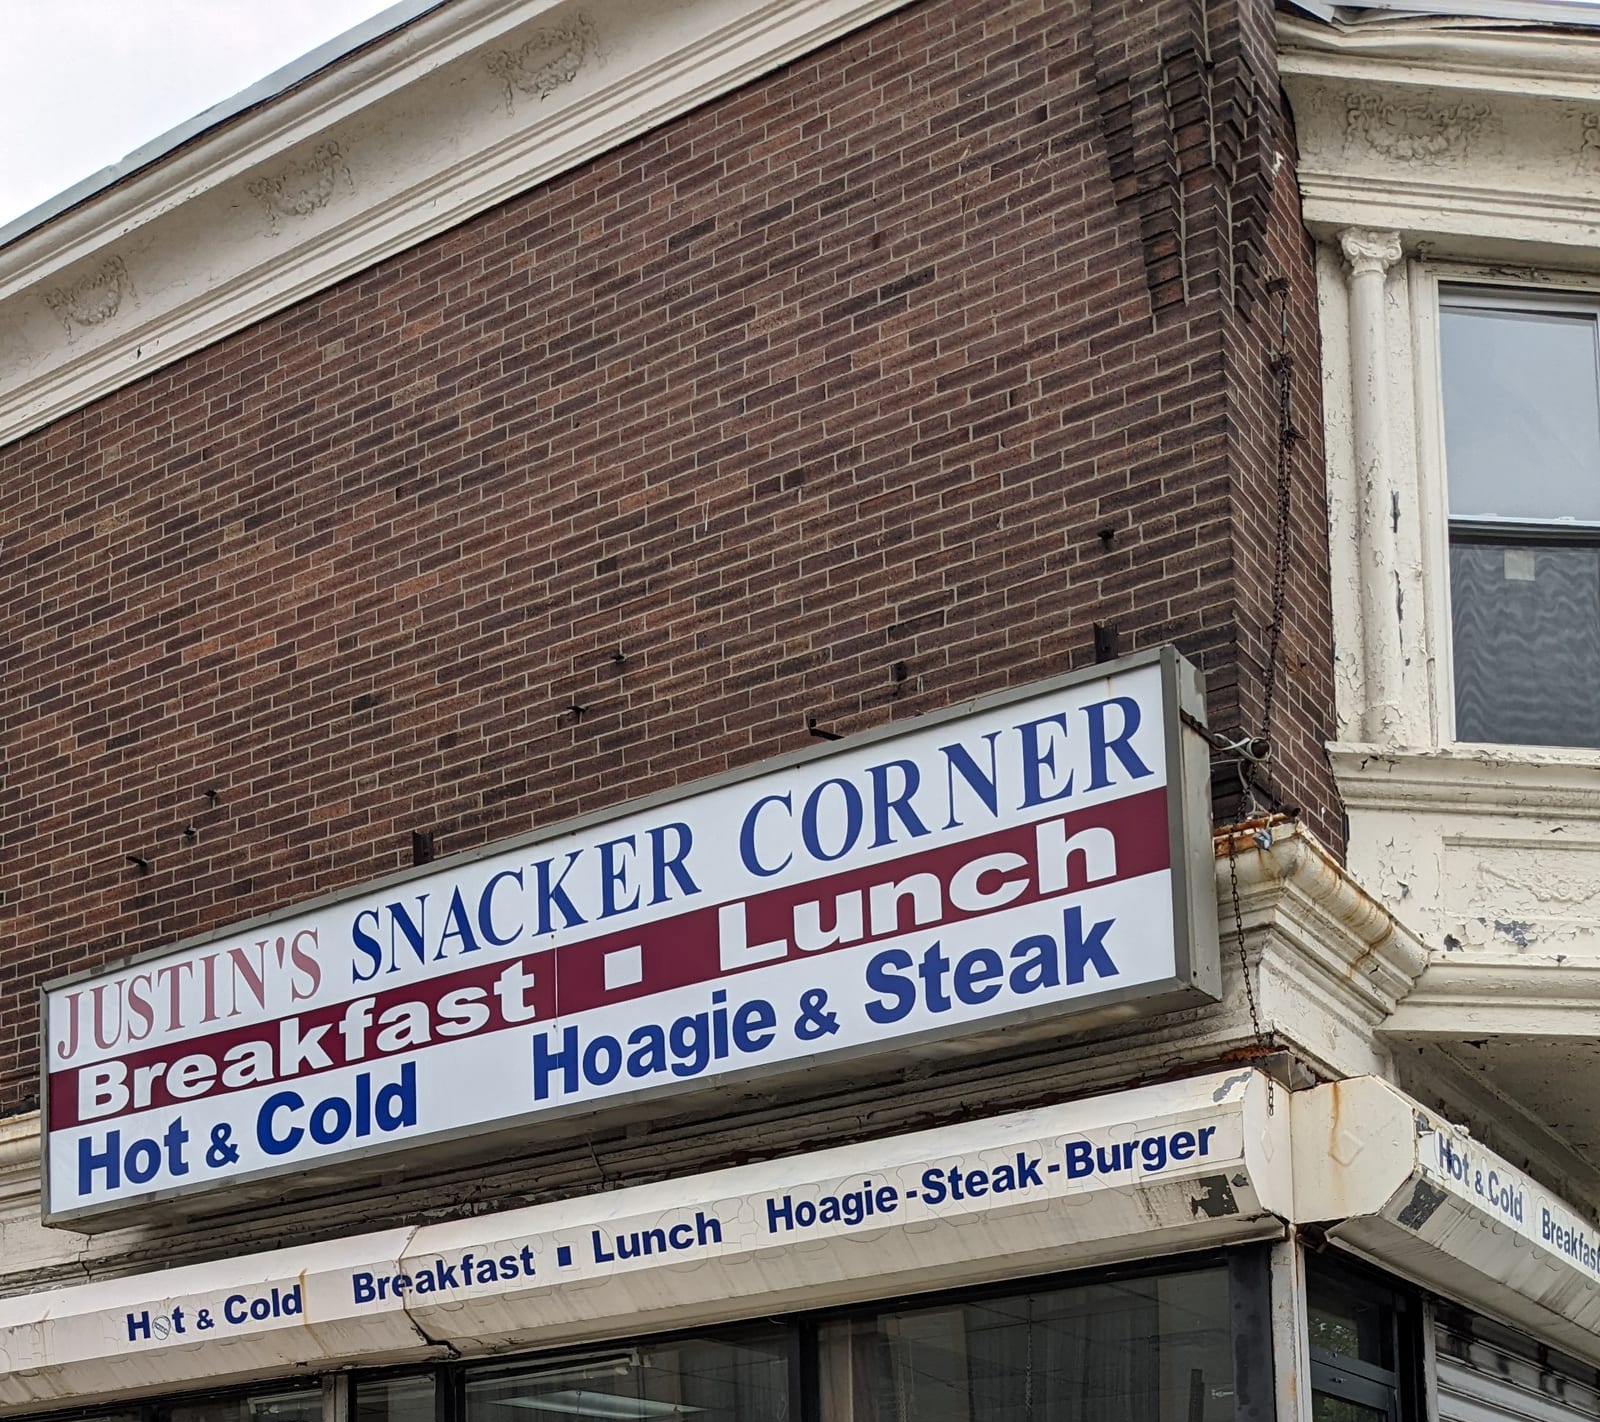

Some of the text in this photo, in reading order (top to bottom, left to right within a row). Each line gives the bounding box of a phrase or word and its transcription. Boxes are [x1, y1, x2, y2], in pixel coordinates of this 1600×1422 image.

[57, 696, 1154, 1061] JUSTIN'S SNACKER CORNER
[77, 818, 1117, 1122] Breakfast Lunch
[78, 905, 1120, 1196] Hot & Cold Hoagie & Steak
[1438, 1131, 1470, 1187] Hot
[1474, 1170, 1485, 1197] &
[1488, 1170, 1523, 1224] Cold
[196, 1309, 215, 1331] &
[223, 1283, 303, 1325] Cold
[352, 1244, 536, 1304] Breakfast
[591, 1212, 722, 1264] Lunch
